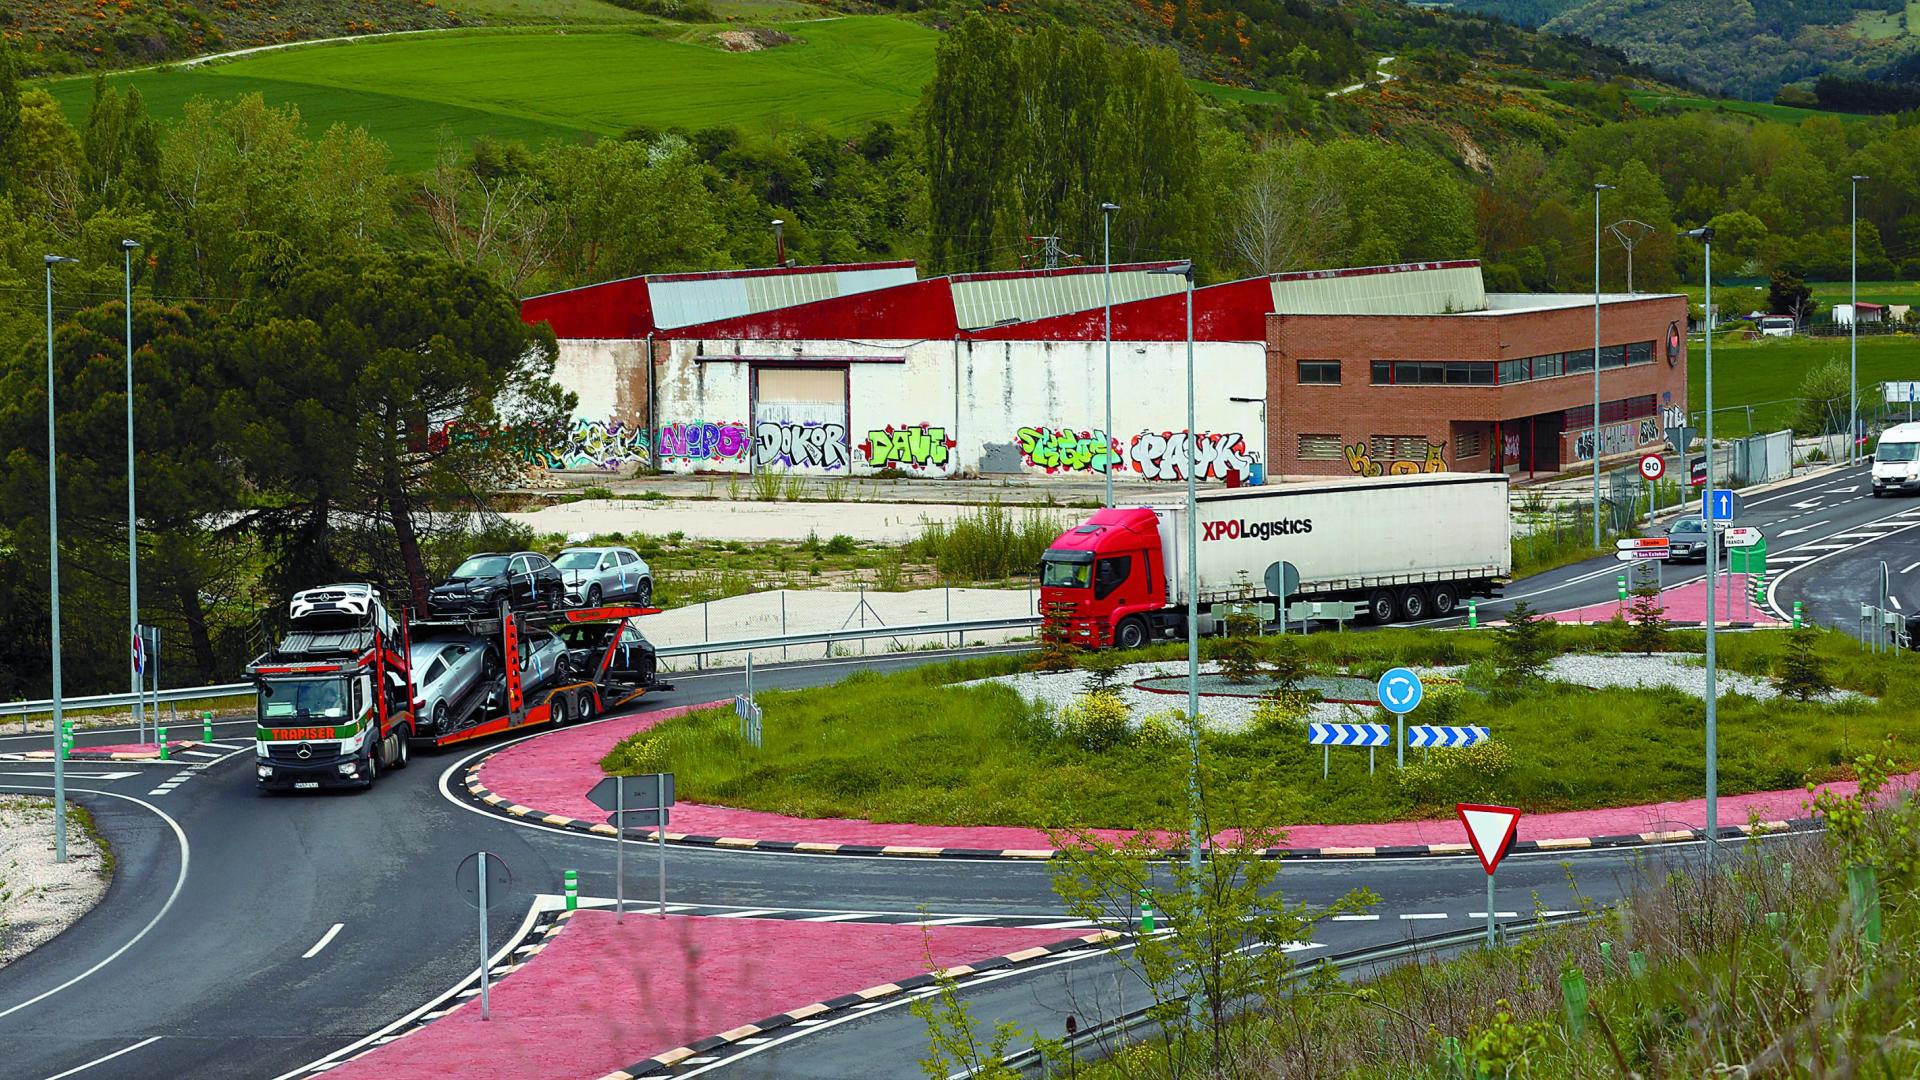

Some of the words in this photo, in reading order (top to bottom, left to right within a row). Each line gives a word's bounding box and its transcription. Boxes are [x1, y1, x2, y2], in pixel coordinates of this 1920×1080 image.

[757, 422, 847, 467] DOKOR
[1644, 462, 1659, 471] 90
[271, 726, 336, 741] TRAPISER
